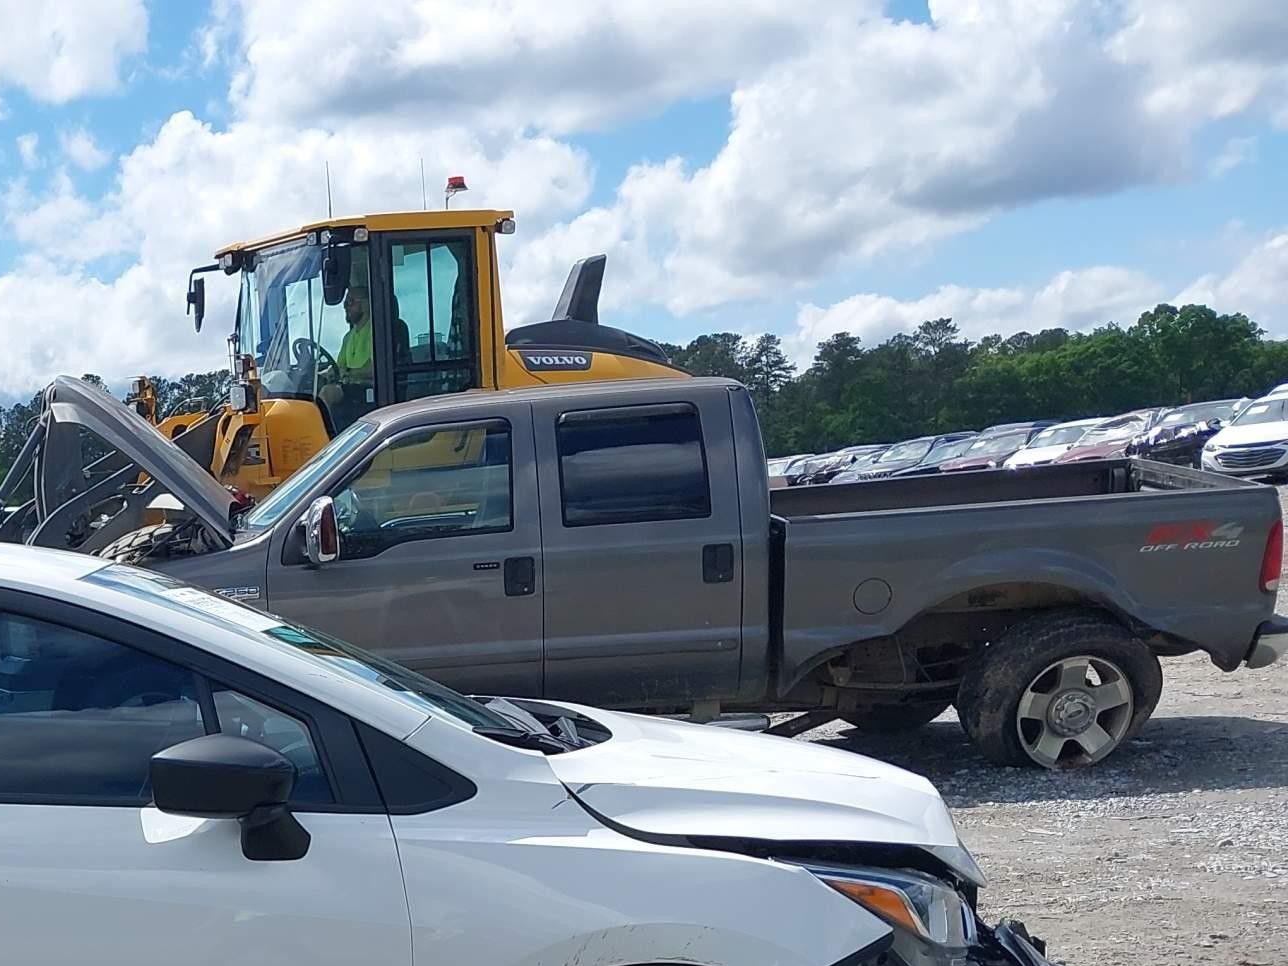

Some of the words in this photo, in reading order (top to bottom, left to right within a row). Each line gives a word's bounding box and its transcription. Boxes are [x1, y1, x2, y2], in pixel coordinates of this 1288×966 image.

[526, 355, 587, 366] VOLVO
[1139, 543, 1178, 553] OFF
[1183, 539, 1241, 550] ROAD
